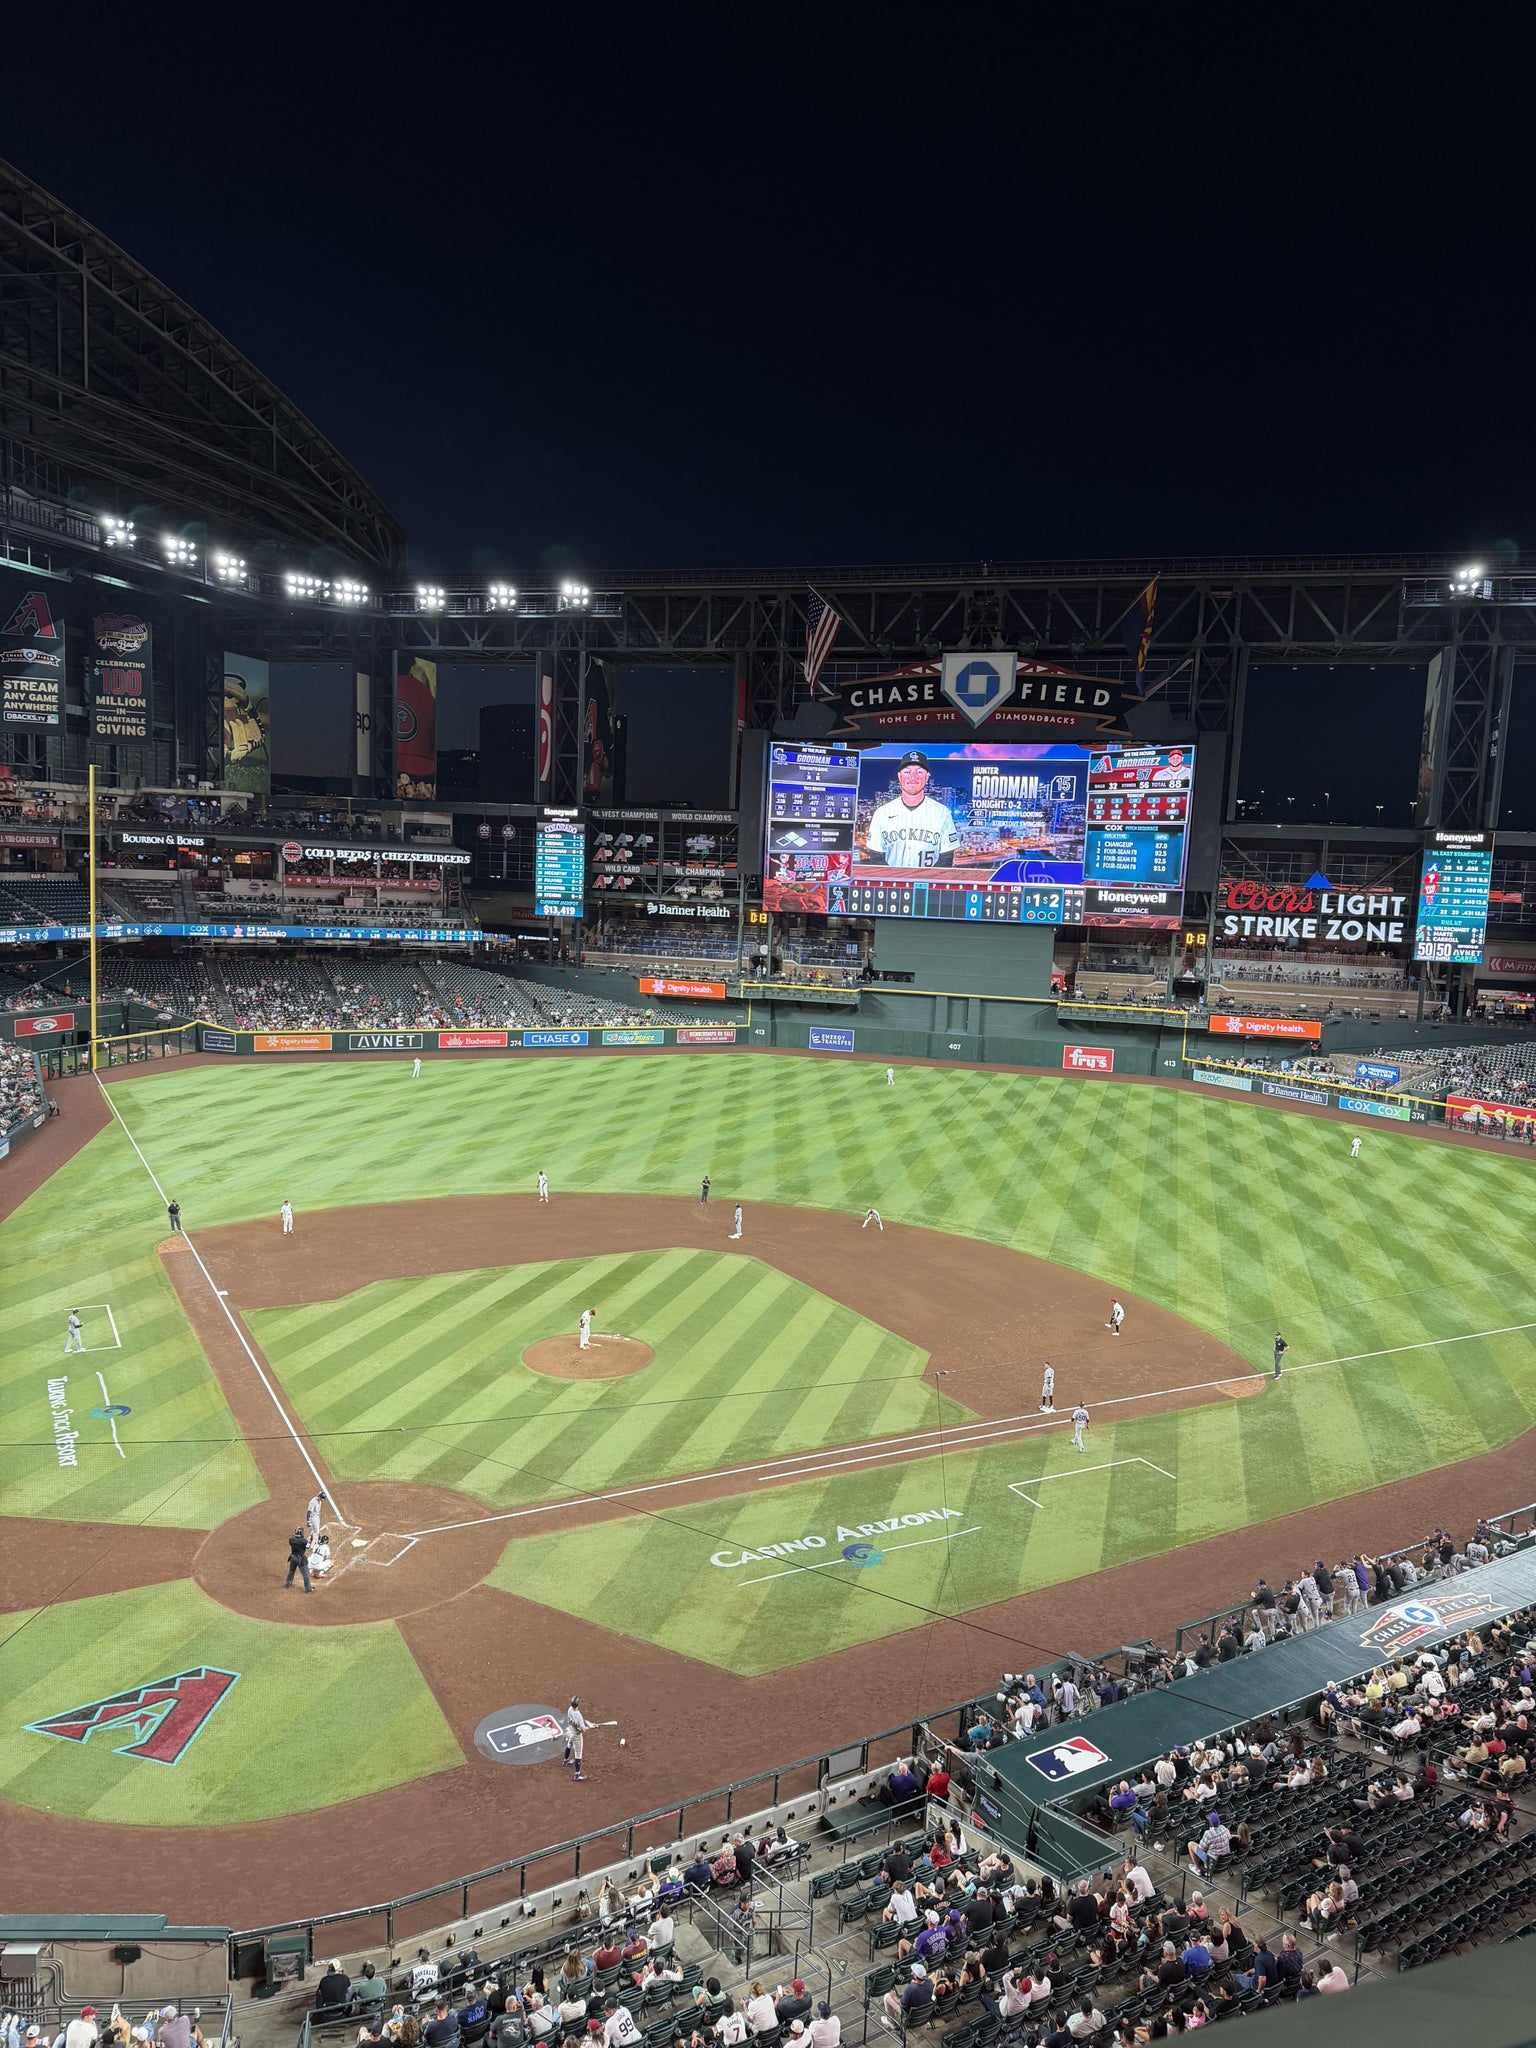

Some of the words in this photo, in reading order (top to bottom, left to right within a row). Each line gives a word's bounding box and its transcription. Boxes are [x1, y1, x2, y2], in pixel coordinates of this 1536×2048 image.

[96, 660, 145, 669] CELEBRATING
[3, 680, 59, 693] STREAM
[4, 692, 26, 701] ANY
[28, 693, 59, 703] GAME
[850, 683, 935, 707] CHASE
[1021, 683, 1111, 707] FIELD
[4, 702, 59, 712] ANYWHERE
[96, 696, 146, 708] MILLION
[96, 715, 146, 724] CHARITABLE
[879, 715, 909, 724] HOME
[936, 712, 956, 721] THE
[995, 712, 1076, 725] DIAMONDBACKS
[96, 724, 146, 736] GIVING
[796, 754, 831, 765] GOODMAN
[1116, 757, 1161, 768] RODRIGUEZ
[973, 766, 999, 775] HUNTER
[1136, 769, 1152, 780] 57
[972, 776, 1039, 799] GOODMAN
[1056, 778, 1071, 792] 15
[1108, 782, 1118, 790] 32
[1169, 780, 1182, 788] 88
[972, 800, 1007, 809] TONIGHT:
[1007, 800, 1022, 810] 0-2
[592, 810, 601, 818] NL
[602, 811, 620, 819] WEST
[621, 811, 658, 820] CHAMPIONS
[671, 812, 693, 821] WORLD
[694, 813, 732, 822] CHAMPIONS
[544, 823, 578, 834] COLORADO
[123, 833, 164, 844] BOURBON
[166, 835, 174, 844] &
[176, 836, 204, 846] BONES
[881, 827, 941, 847] ROCKIES
[1435, 832, 1484, 843] Honeywell
[305, 848, 333, 858] COLD
[337, 849, 371, 860] BEERS
[373, 851, 380, 860] &
[381, 851, 471, 864] CHEESEBURGERS
[918, 850, 935, 868] 15
[605, 865, 622, 873] WILD
[623, 865, 641, 873] CARD
[686, 868, 726, 877] CHAMPIONS
[970, 894, 978, 904] 0
[984, 895, 992, 904] 4
[999, 895, 1006, 904] 0
[1012, 896, 1019, 905] 2
[1025, 895, 1032, 904] B
[1032, 893, 1041, 906] 1
[1049, 894, 1060, 908] 2
[1098, 890, 1167, 904] Honeywell
[1226, 880, 1316, 913] Coors
[1320, 893, 1407, 917] LIGHT
[1065, 899, 1071, 907] 2
[543, 905, 576, 916] $13,419
[659, 903, 696, 916] Banner
[697, 905, 731, 918] Health
[969, 908, 977, 917] 0
[998, 908, 1005, 918] 0
[1010, 909, 1018, 918] 2
[1063, 912, 1070, 920] 2
[1074, 912, 1080, 920] 3
[1113, 907, 1149, 915] AEROSPACE
[1224, 915, 1318, 939] STRIKE
[1325, 919, 1404, 943] ZONE
[667, 984, 690, 993] Dignity
[1245, 1022, 1276, 1032] Dignity
[358, 1035, 416, 1048] AVNET
[465, 1037, 502, 1045] Budweiser
[531, 1035, 569, 1044] CHASE
[821, 1037, 852, 1046] TRANSFER
[948, 1043, 961, 1051] 407
[1068, 1048, 1108, 1069] fry's
[1163, 1059, 1176, 1067] 413
[1274, 1085, 1300, 1099] Banner
[1300, 1090, 1323, 1103] Health
[1347, 1100, 1370, 1112] COX
[1377, 1106, 1401, 1117] COX
[1411, 1112, 1425, 1120] 374
[47, 1375, 69, 1409] TALKING
[51, 1408, 75, 1434] STICK
[55, 1430, 80, 1467] RESORT
[709, 1535, 827, 1568] CASINO
[836, 1507, 964, 1542] ARIZONA
[1373, 1619, 1412, 1642] CHASE
[1439, 1597, 1480, 1616] FIELD
[618, 2017, 635, 2037] 99
[732, 2026, 740, 2042] 7
